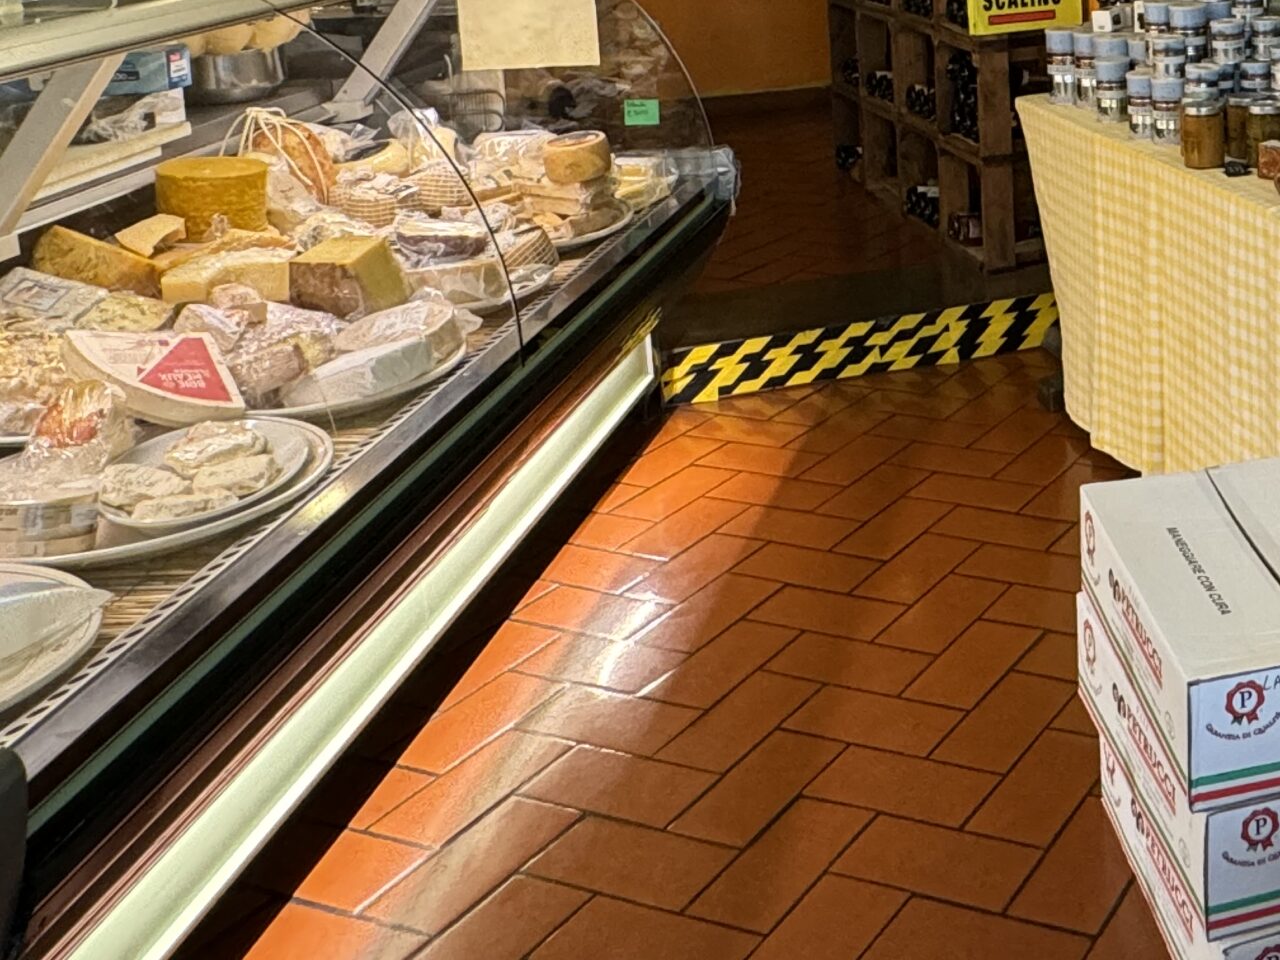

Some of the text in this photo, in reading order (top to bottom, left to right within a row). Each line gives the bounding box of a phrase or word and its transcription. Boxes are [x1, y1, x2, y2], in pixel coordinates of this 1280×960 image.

[1208, 592, 1231, 615] CURA
[1239, 690, 1253, 709] P
[1254, 817, 1267, 836] P
